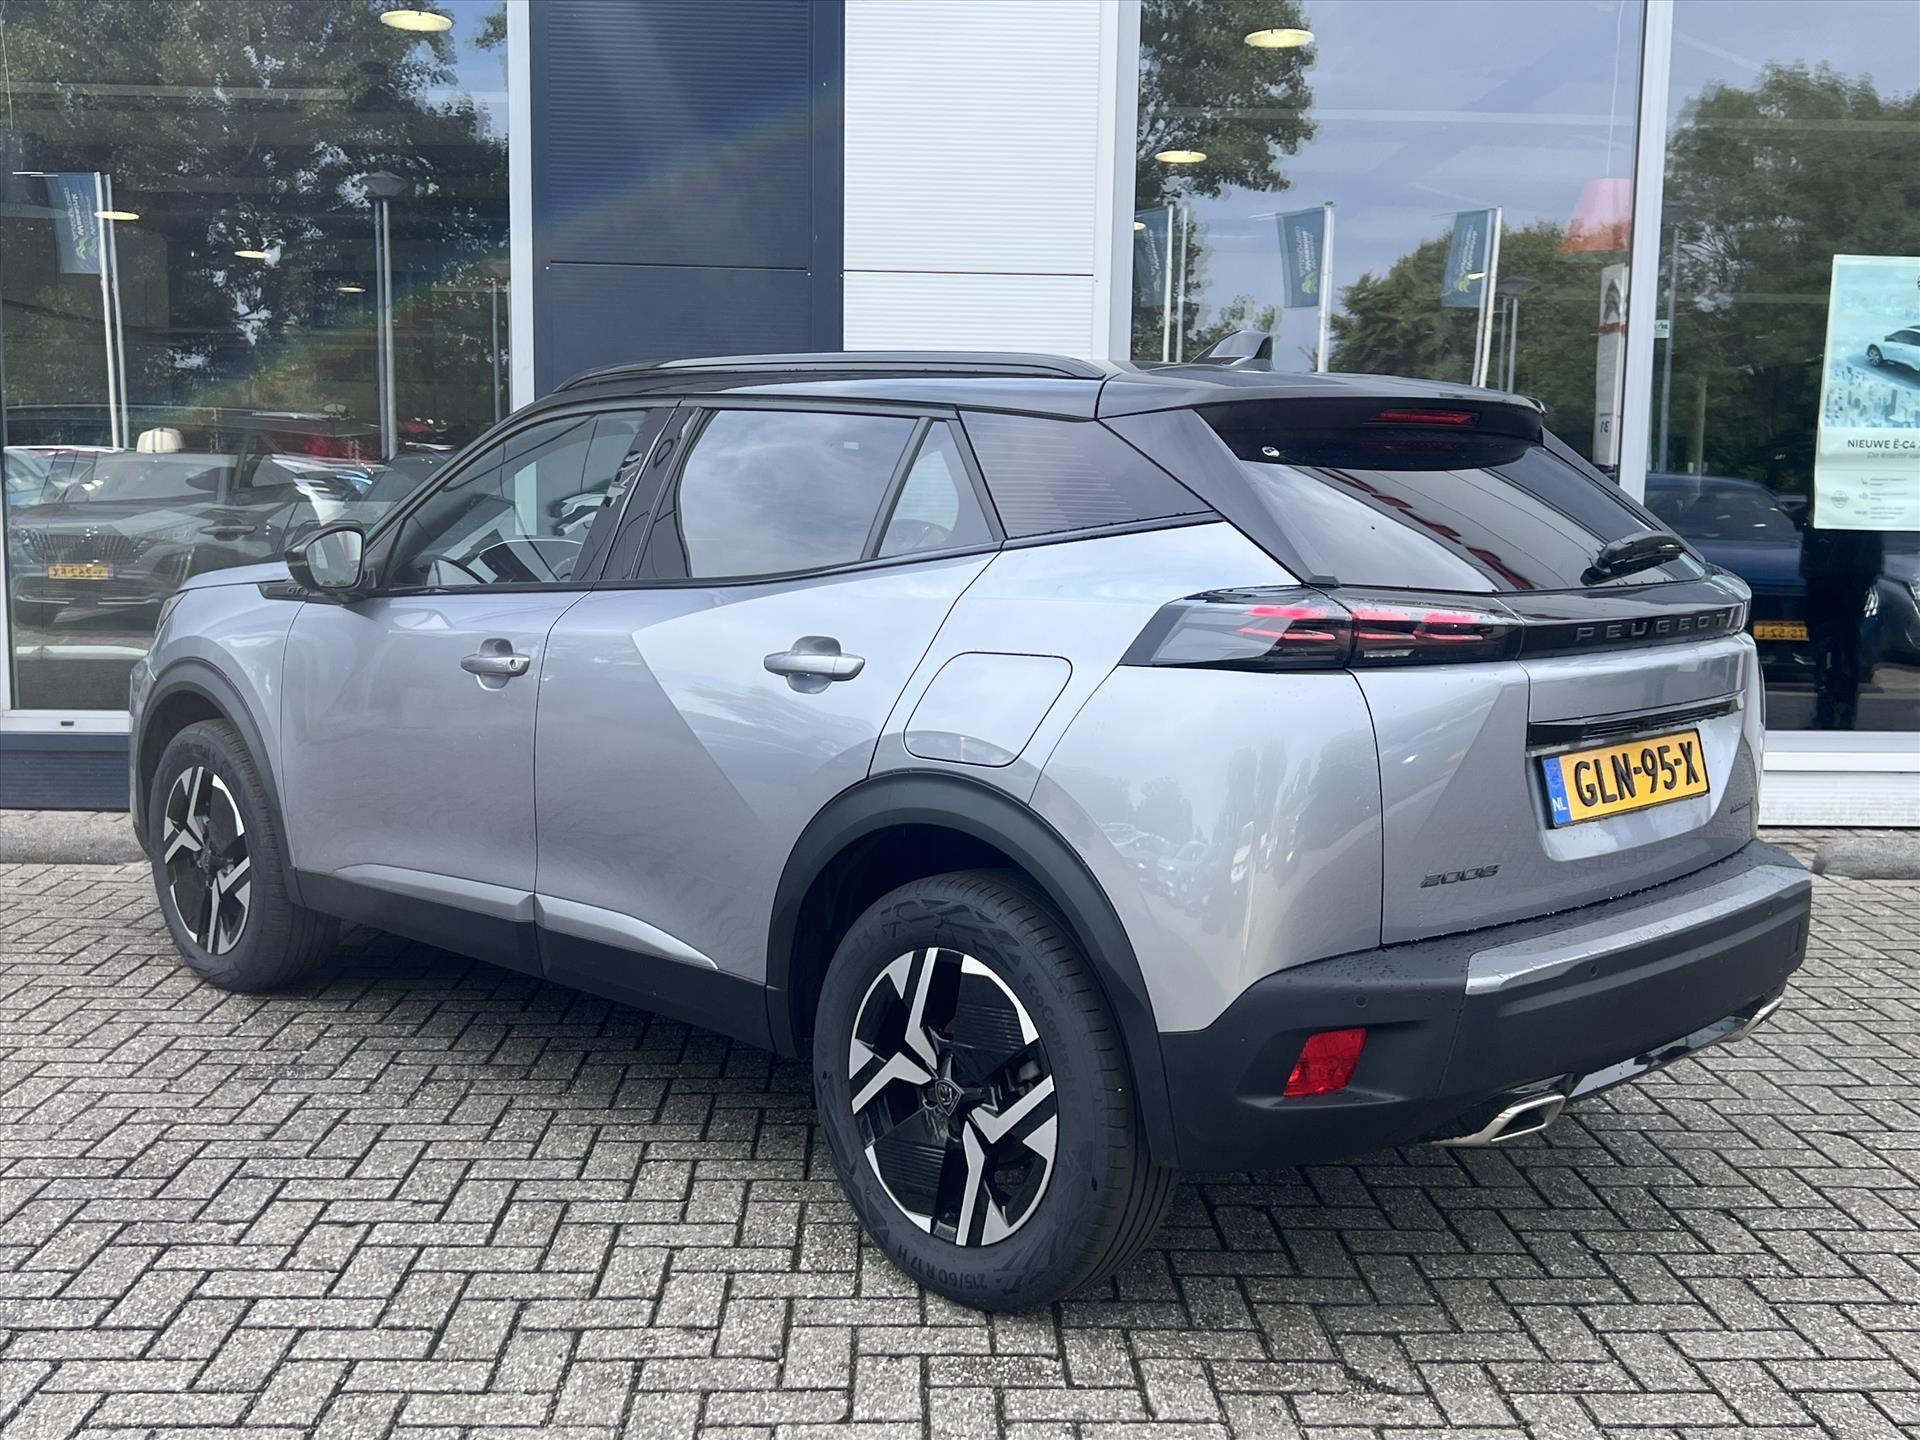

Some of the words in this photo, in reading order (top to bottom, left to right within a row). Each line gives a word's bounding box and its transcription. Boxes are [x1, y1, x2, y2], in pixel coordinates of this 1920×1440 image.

[1847, 439, 1891, 449] NIEUWE
[1576, 613, 1726, 641] PEUGEOT
[1574, 741, 1700, 807] GLN-95-X
[1551, 798, 1567, 812] NL
[1420, 864, 1500, 888] 2008
[897, 1244, 908, 1262] H
[910, 1256, 922, 1274] 17
[926, 1262, 936, 1281] R
[938, 1269, 988, 1289] 215/60
